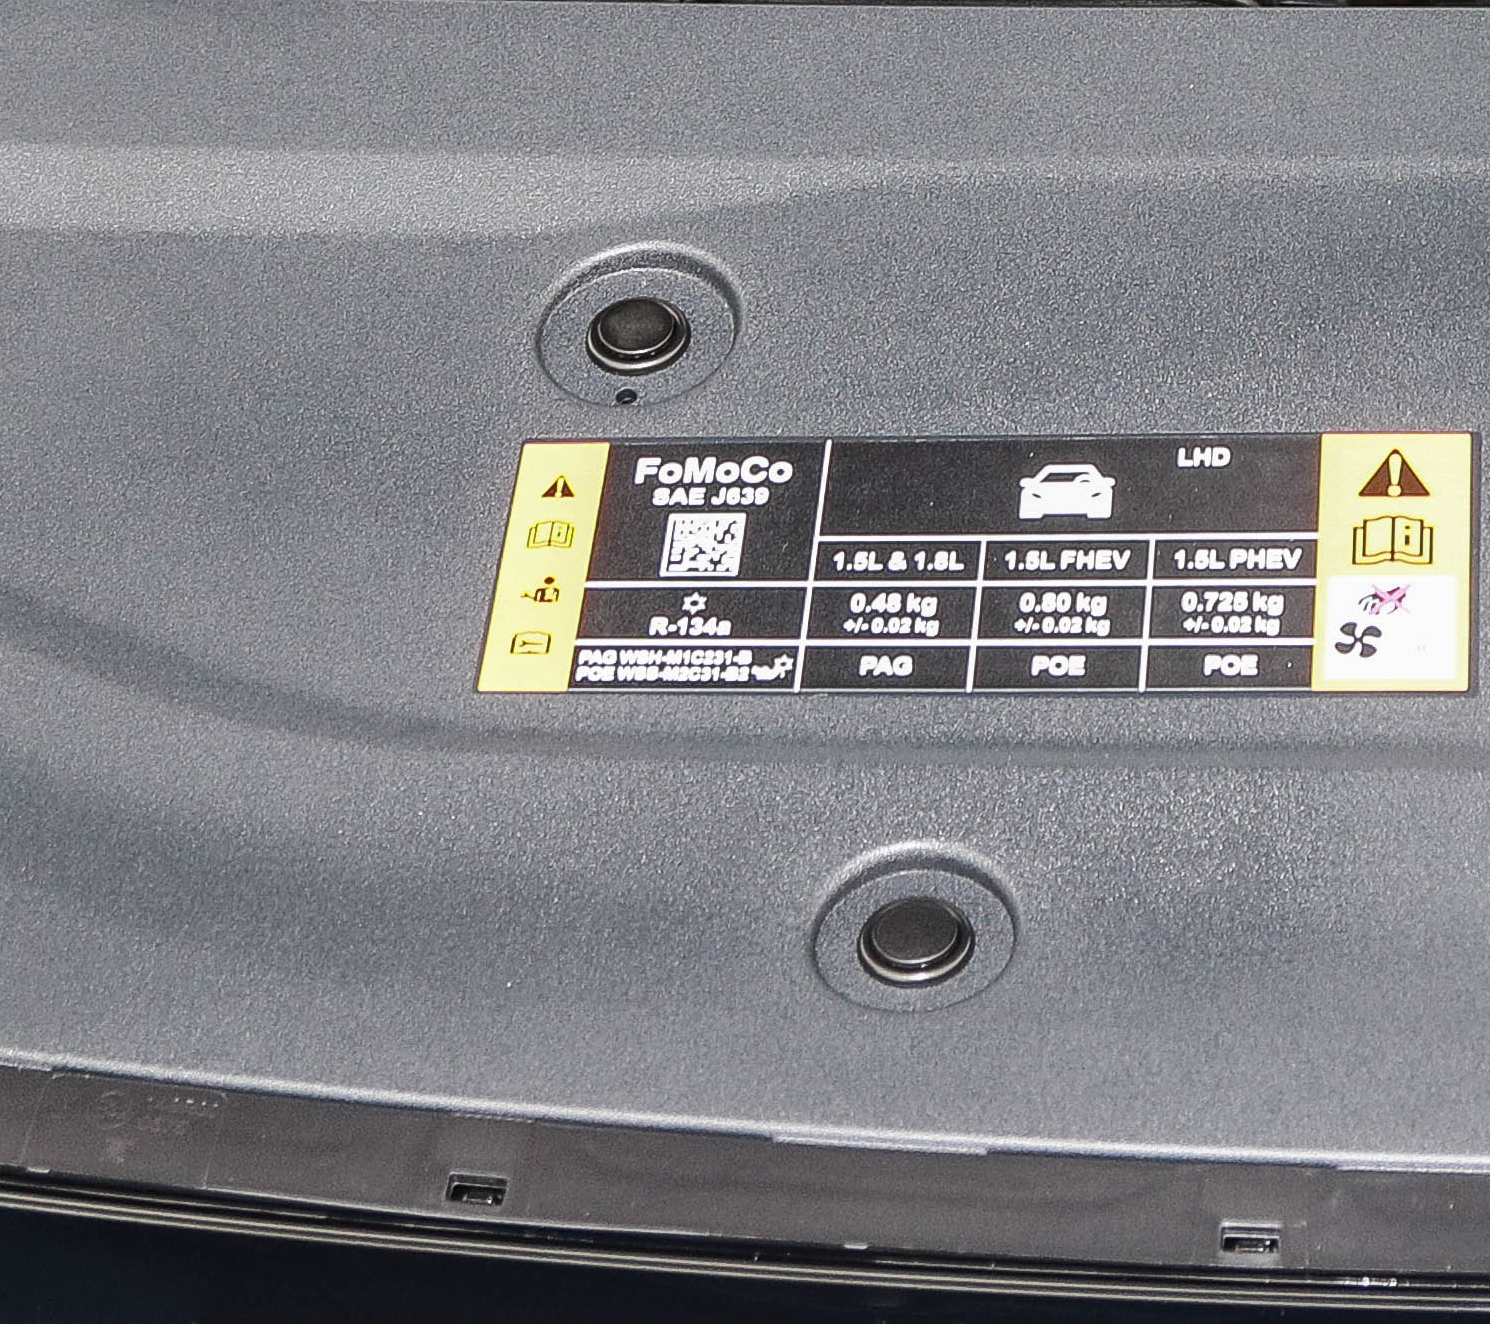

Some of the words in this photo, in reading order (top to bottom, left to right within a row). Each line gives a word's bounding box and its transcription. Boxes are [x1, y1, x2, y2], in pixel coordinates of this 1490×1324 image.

[1177, 447, 1231, 467] LHD
[634, 456, 793, 486] FoMoCo
[652, 487, 705, 506] SAE
[834, 551, 883, 570] 1.5L
[888, 551, 907, 570] &
[1061, 550, 1131, 570] FHEV
[1230, 549, 1302, 569] PHEV
[907, 593, 937, 617] kg
[1076, 592, 1107, 616] kg
[1253, 591, 1284, 616] kg
[649, 617, 732, 636] R-134a
[915, 616, 939, 636] kg
[1085, 616, 1110, 636] kg
[1255, 616, 1280, 636] kg
[579, 650, 617, 665] PAG
[859, 656, 913, 677] PAG
[1031, 655, 1086, 677] POE
[1203, 655, 1258, 677] POE
[576, 666, 616, 682] POE
